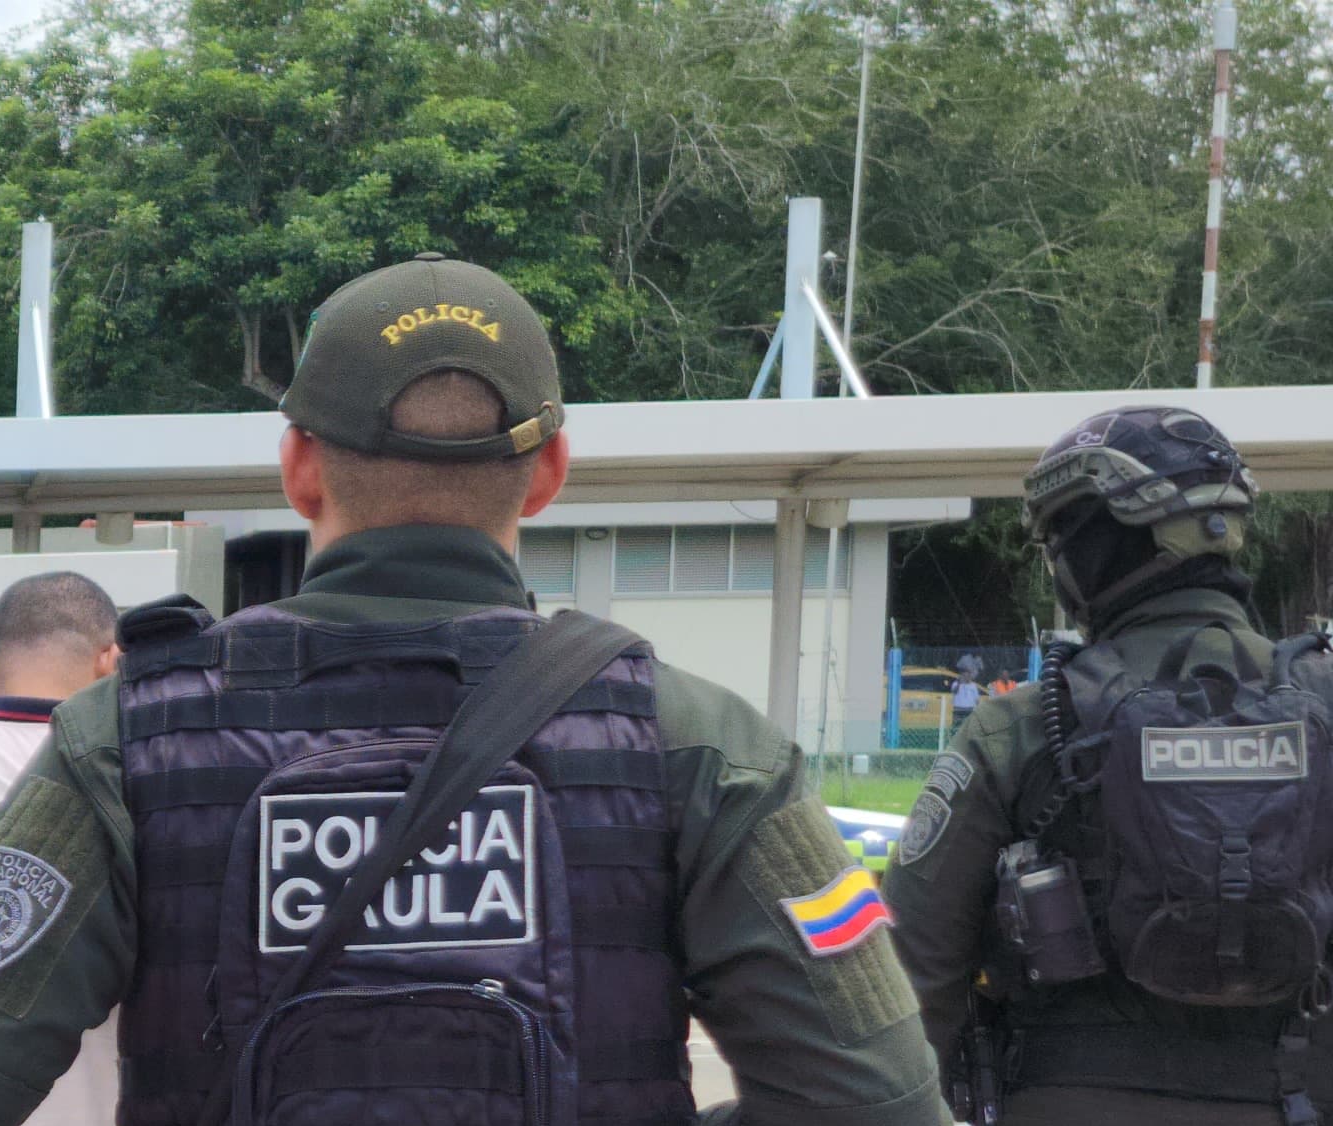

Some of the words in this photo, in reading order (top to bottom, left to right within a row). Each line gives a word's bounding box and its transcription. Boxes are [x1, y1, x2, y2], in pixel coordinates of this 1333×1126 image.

[380, 303, 501, 345] POLICIA
[1149, 732, 1297, 768] POLICÍA
[271, 869, 524, 930] GULA
